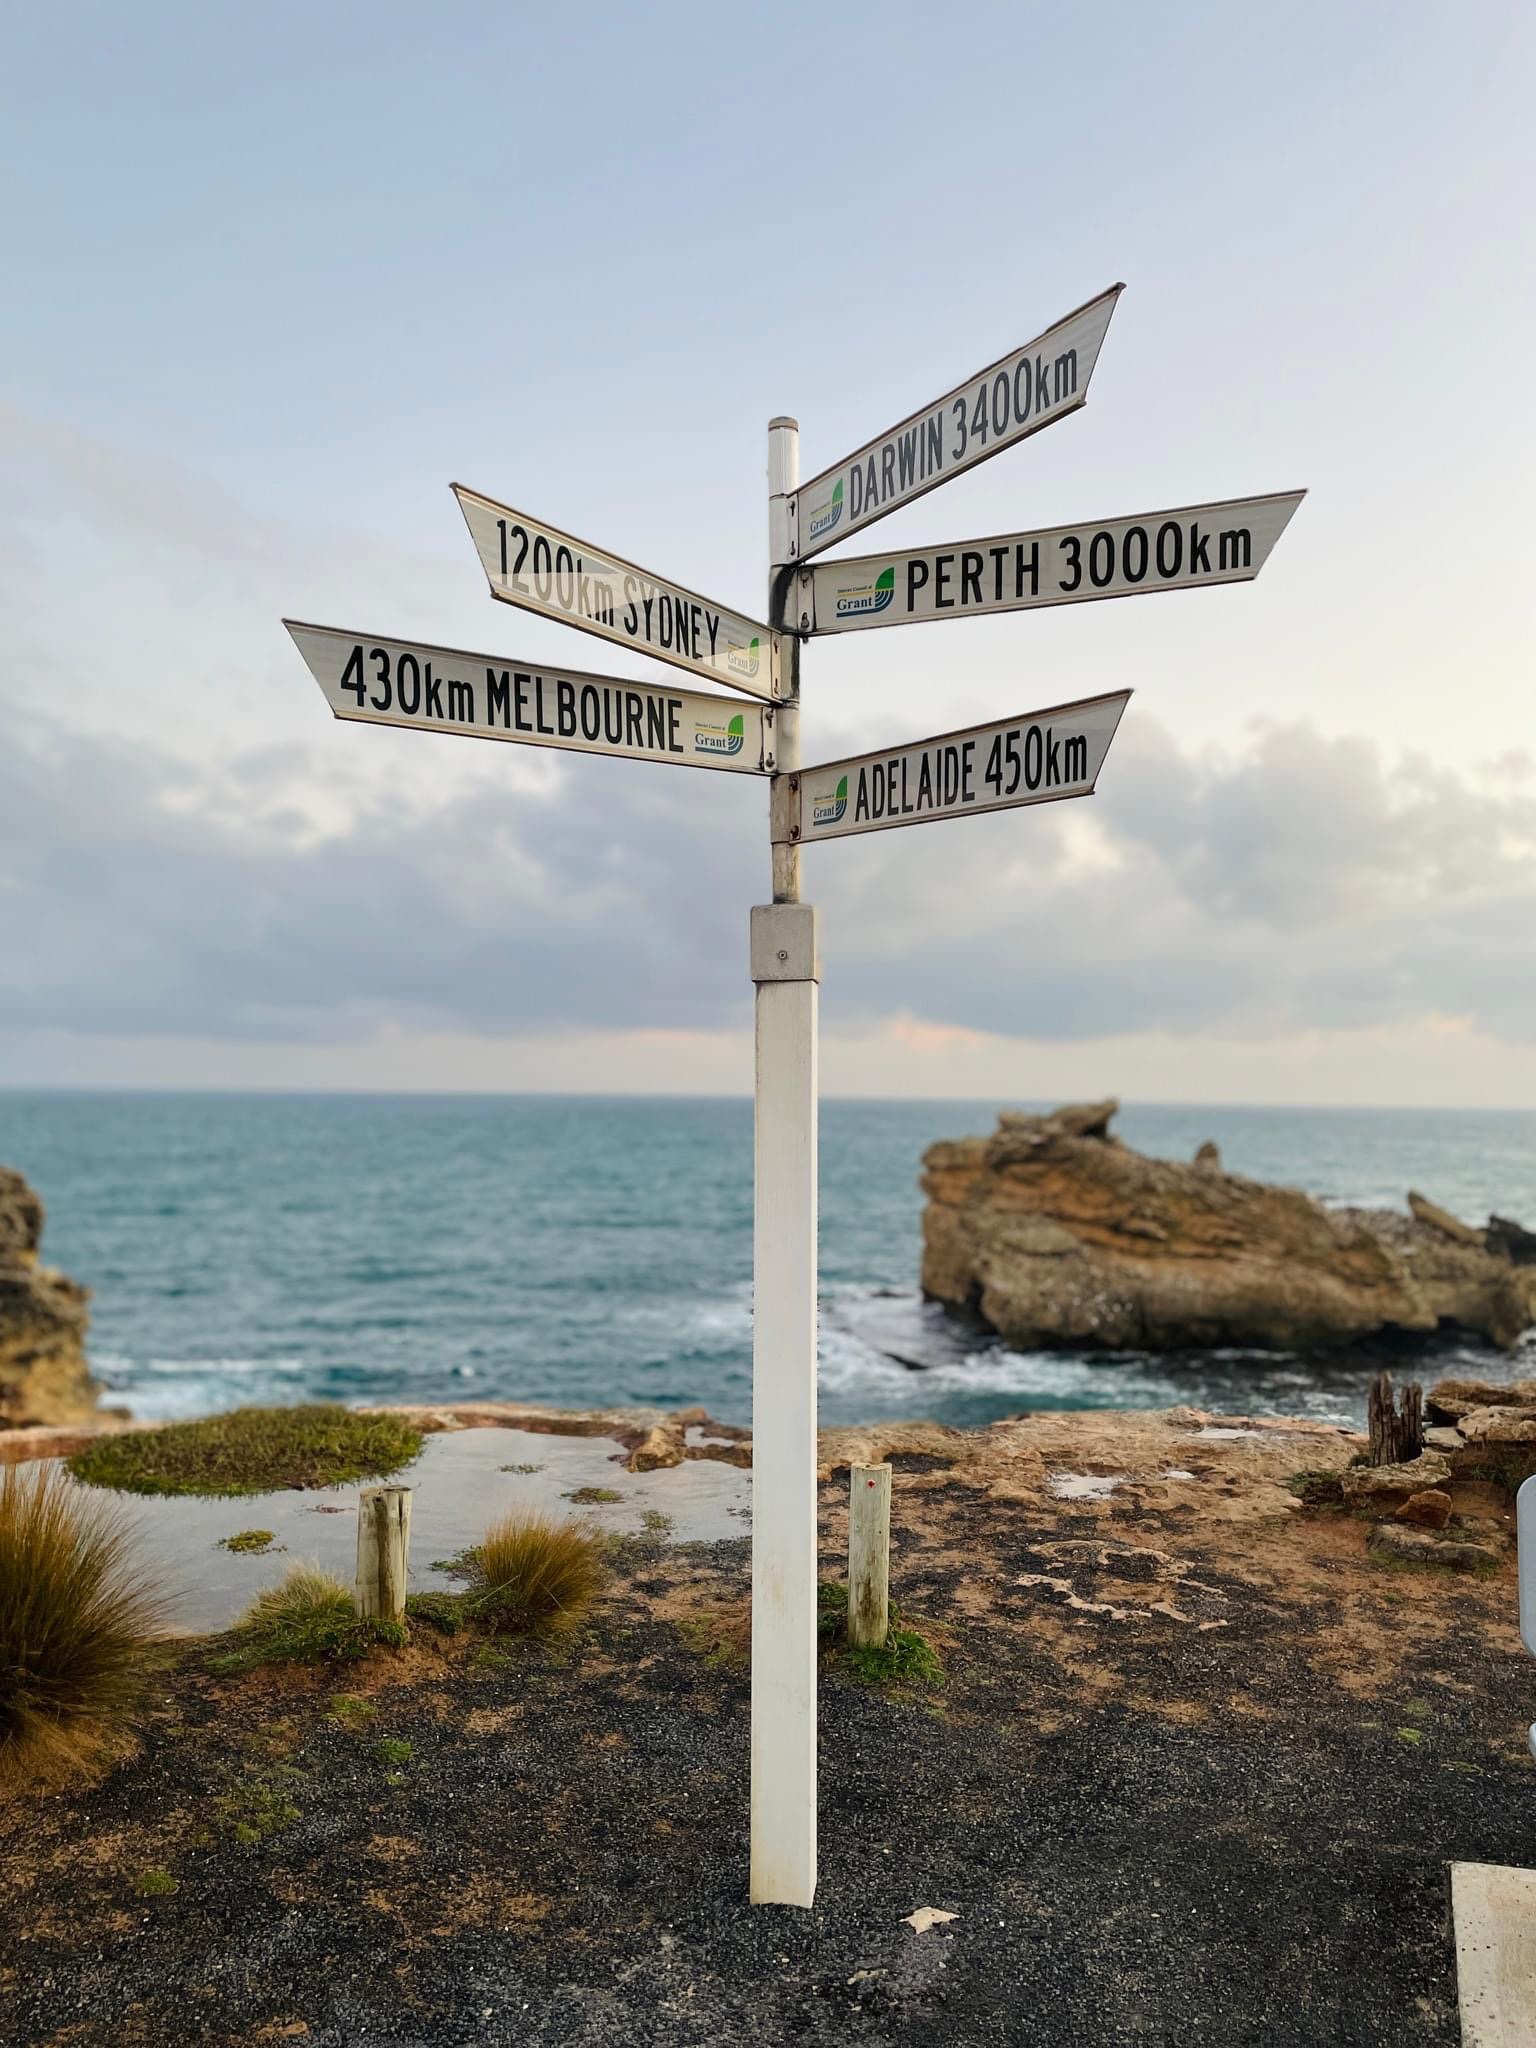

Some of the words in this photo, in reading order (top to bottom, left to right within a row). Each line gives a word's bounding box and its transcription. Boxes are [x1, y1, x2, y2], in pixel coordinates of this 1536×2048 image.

[850, 411, 943, 521] DARWIN
[952, 348, 1078, 460] 3400km
[810, 513, 831, 533] Grant
[907, 542, 1039, 612] PERTH
[1059, 521, 1251, 592] 3000km
[496, 519, 614, 627] 1200km
[623, 575, 719, 667] SYDNEY
[837, 597, 872, 611] Grant
[341, 645, 474, 723] 430km
[486, 668, 684, 753] MELBOURNE
[695, 733, 726, 748] Grant
[814, 806, 835, 819] Grant
[855, 741, 976, 822] ADELAIDE
[985, 725, 1087, 796] 450km
